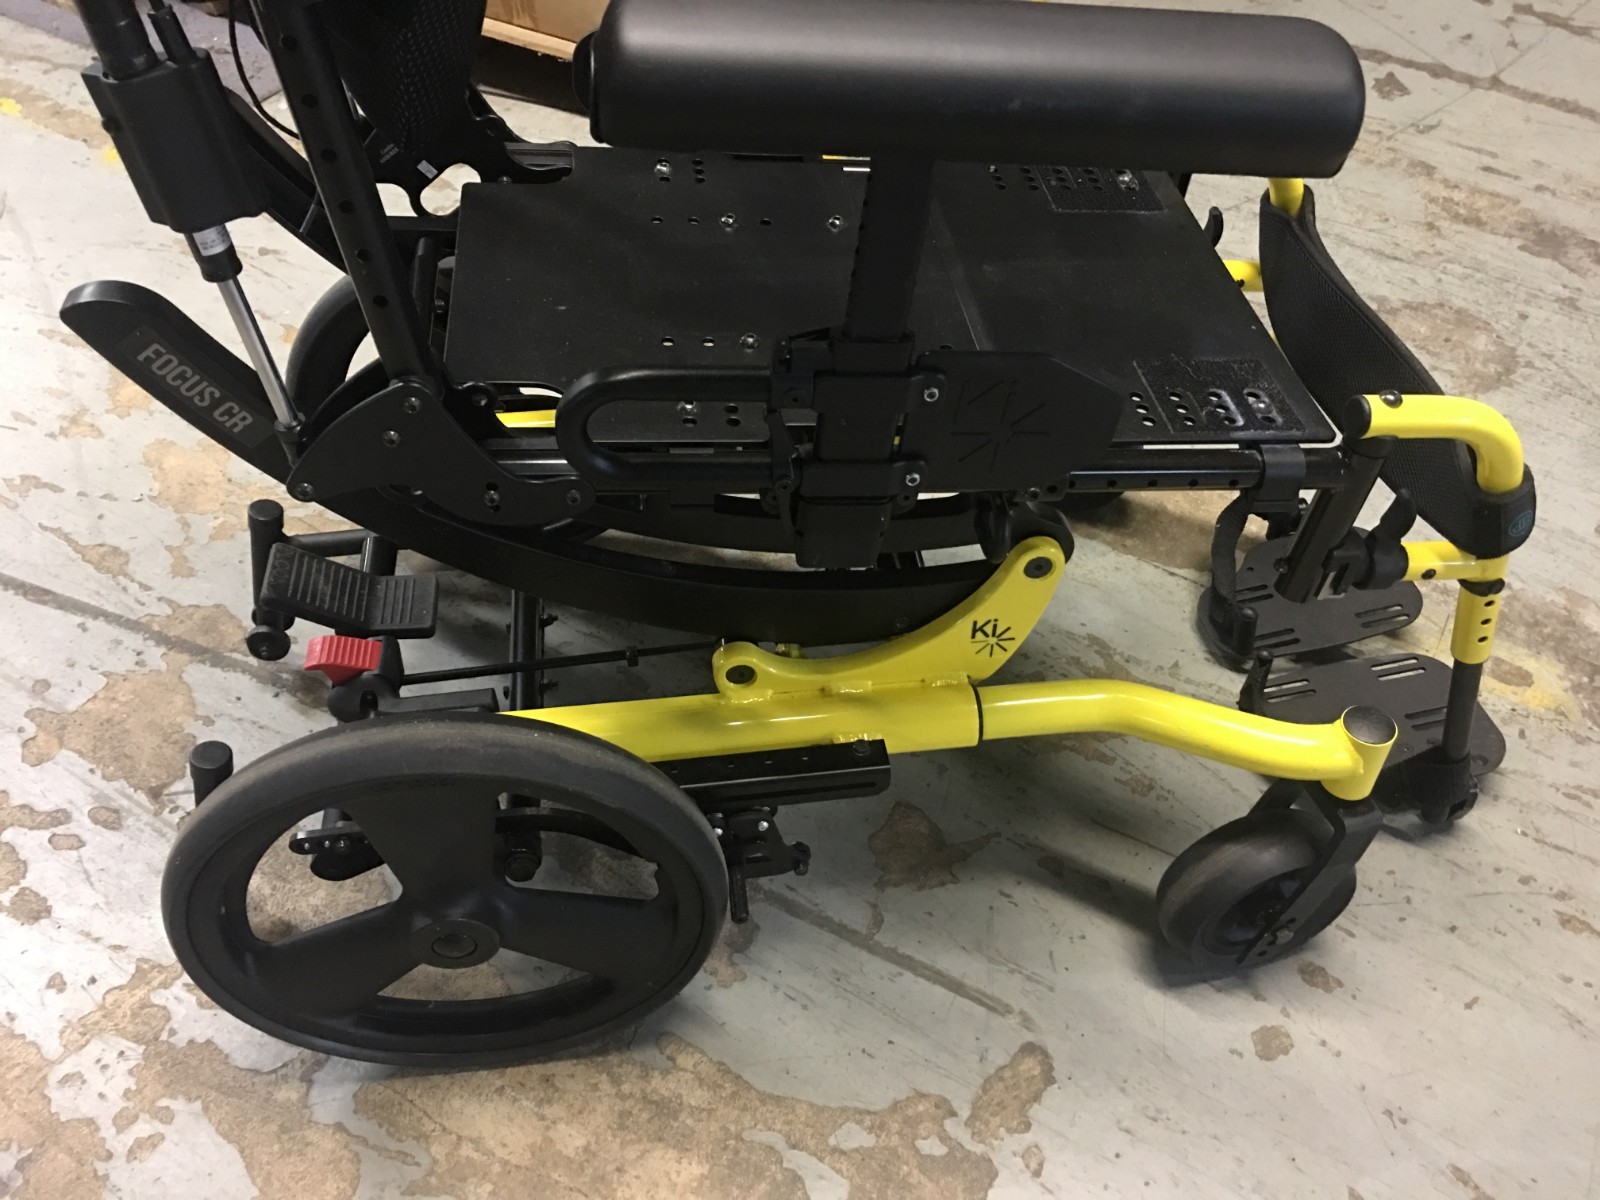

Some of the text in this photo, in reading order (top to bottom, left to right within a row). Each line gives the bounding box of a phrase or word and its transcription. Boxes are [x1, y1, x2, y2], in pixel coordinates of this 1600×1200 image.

[137, 343, 253, 433] FOCUS CR
[971, 619, 998, 639] Ki
